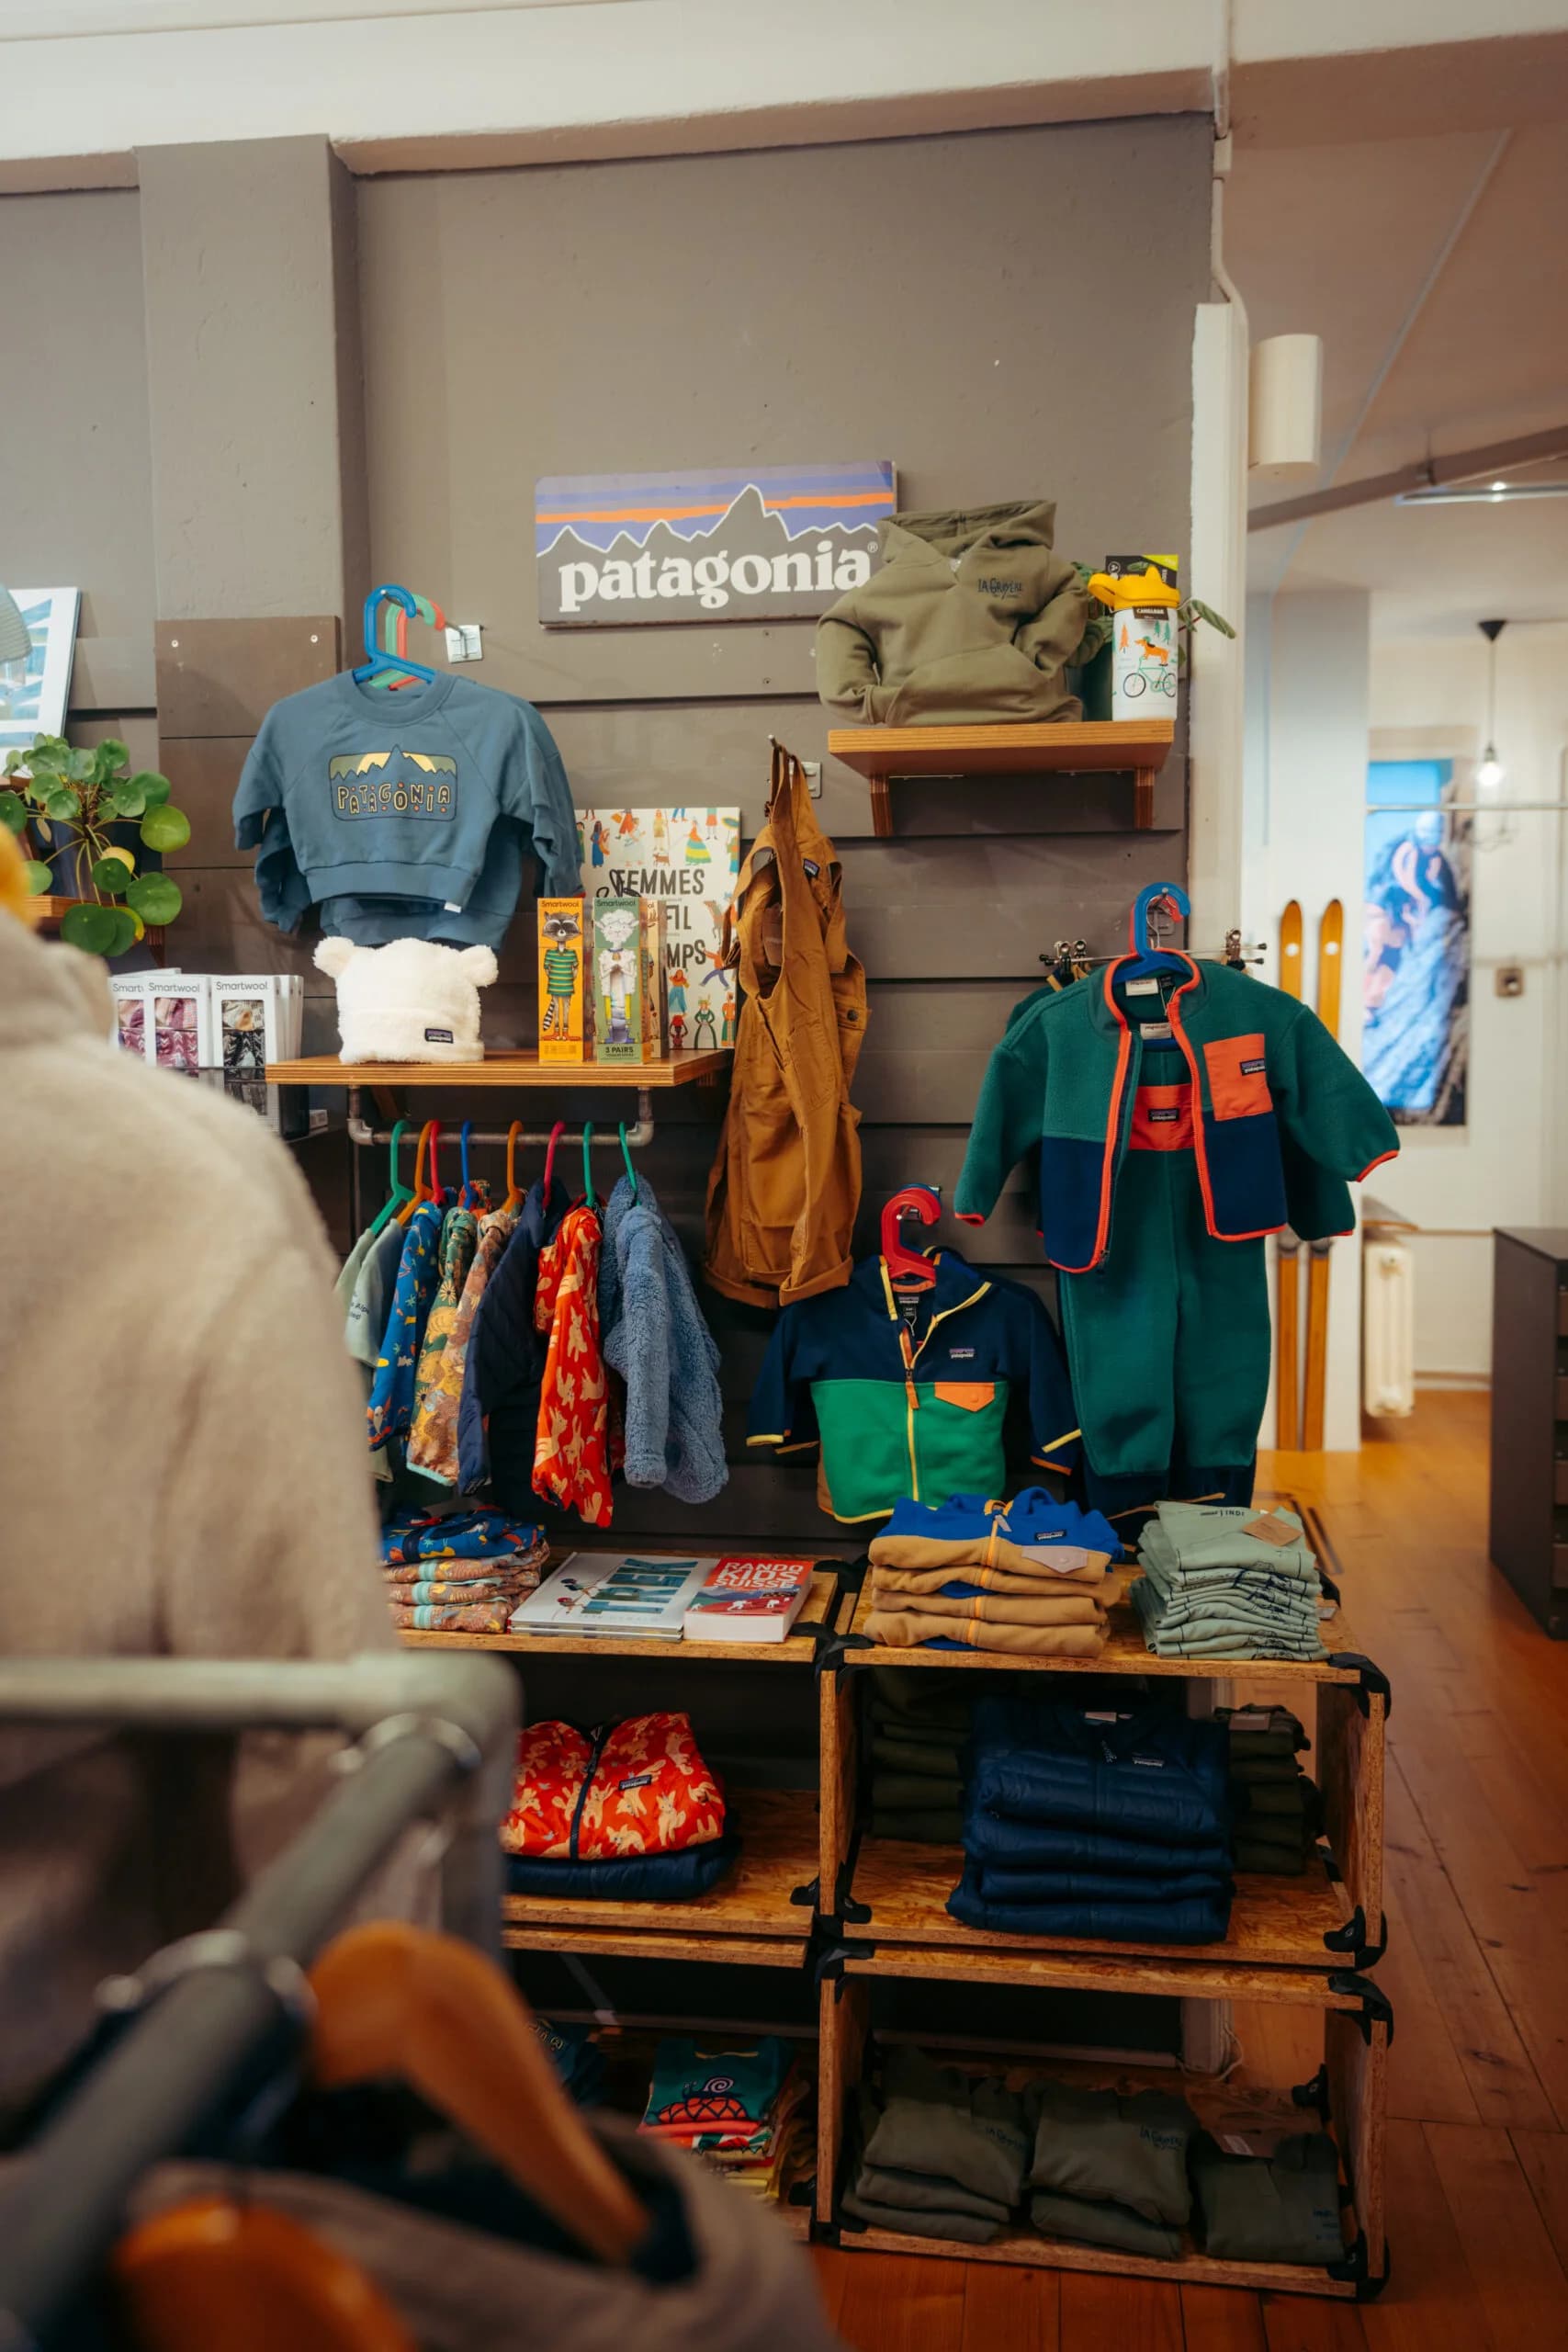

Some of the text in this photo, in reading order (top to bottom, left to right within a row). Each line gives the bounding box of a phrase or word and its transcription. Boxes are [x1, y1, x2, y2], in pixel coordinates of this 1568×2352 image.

[337, 784, 450, 814] PATAGONIA
[666, 939, 706, 969] MPS
[148, 982, 200, 994] Smartwool
[216, 981, 268, 991] Smartwool
[724, 1562, 805, 1574] RANDO
[717, 1569, 798, 1581] KIDS
[581, 1558, 698, 1614] TREK
[713, 1579, 795, 1589] SUISSE
